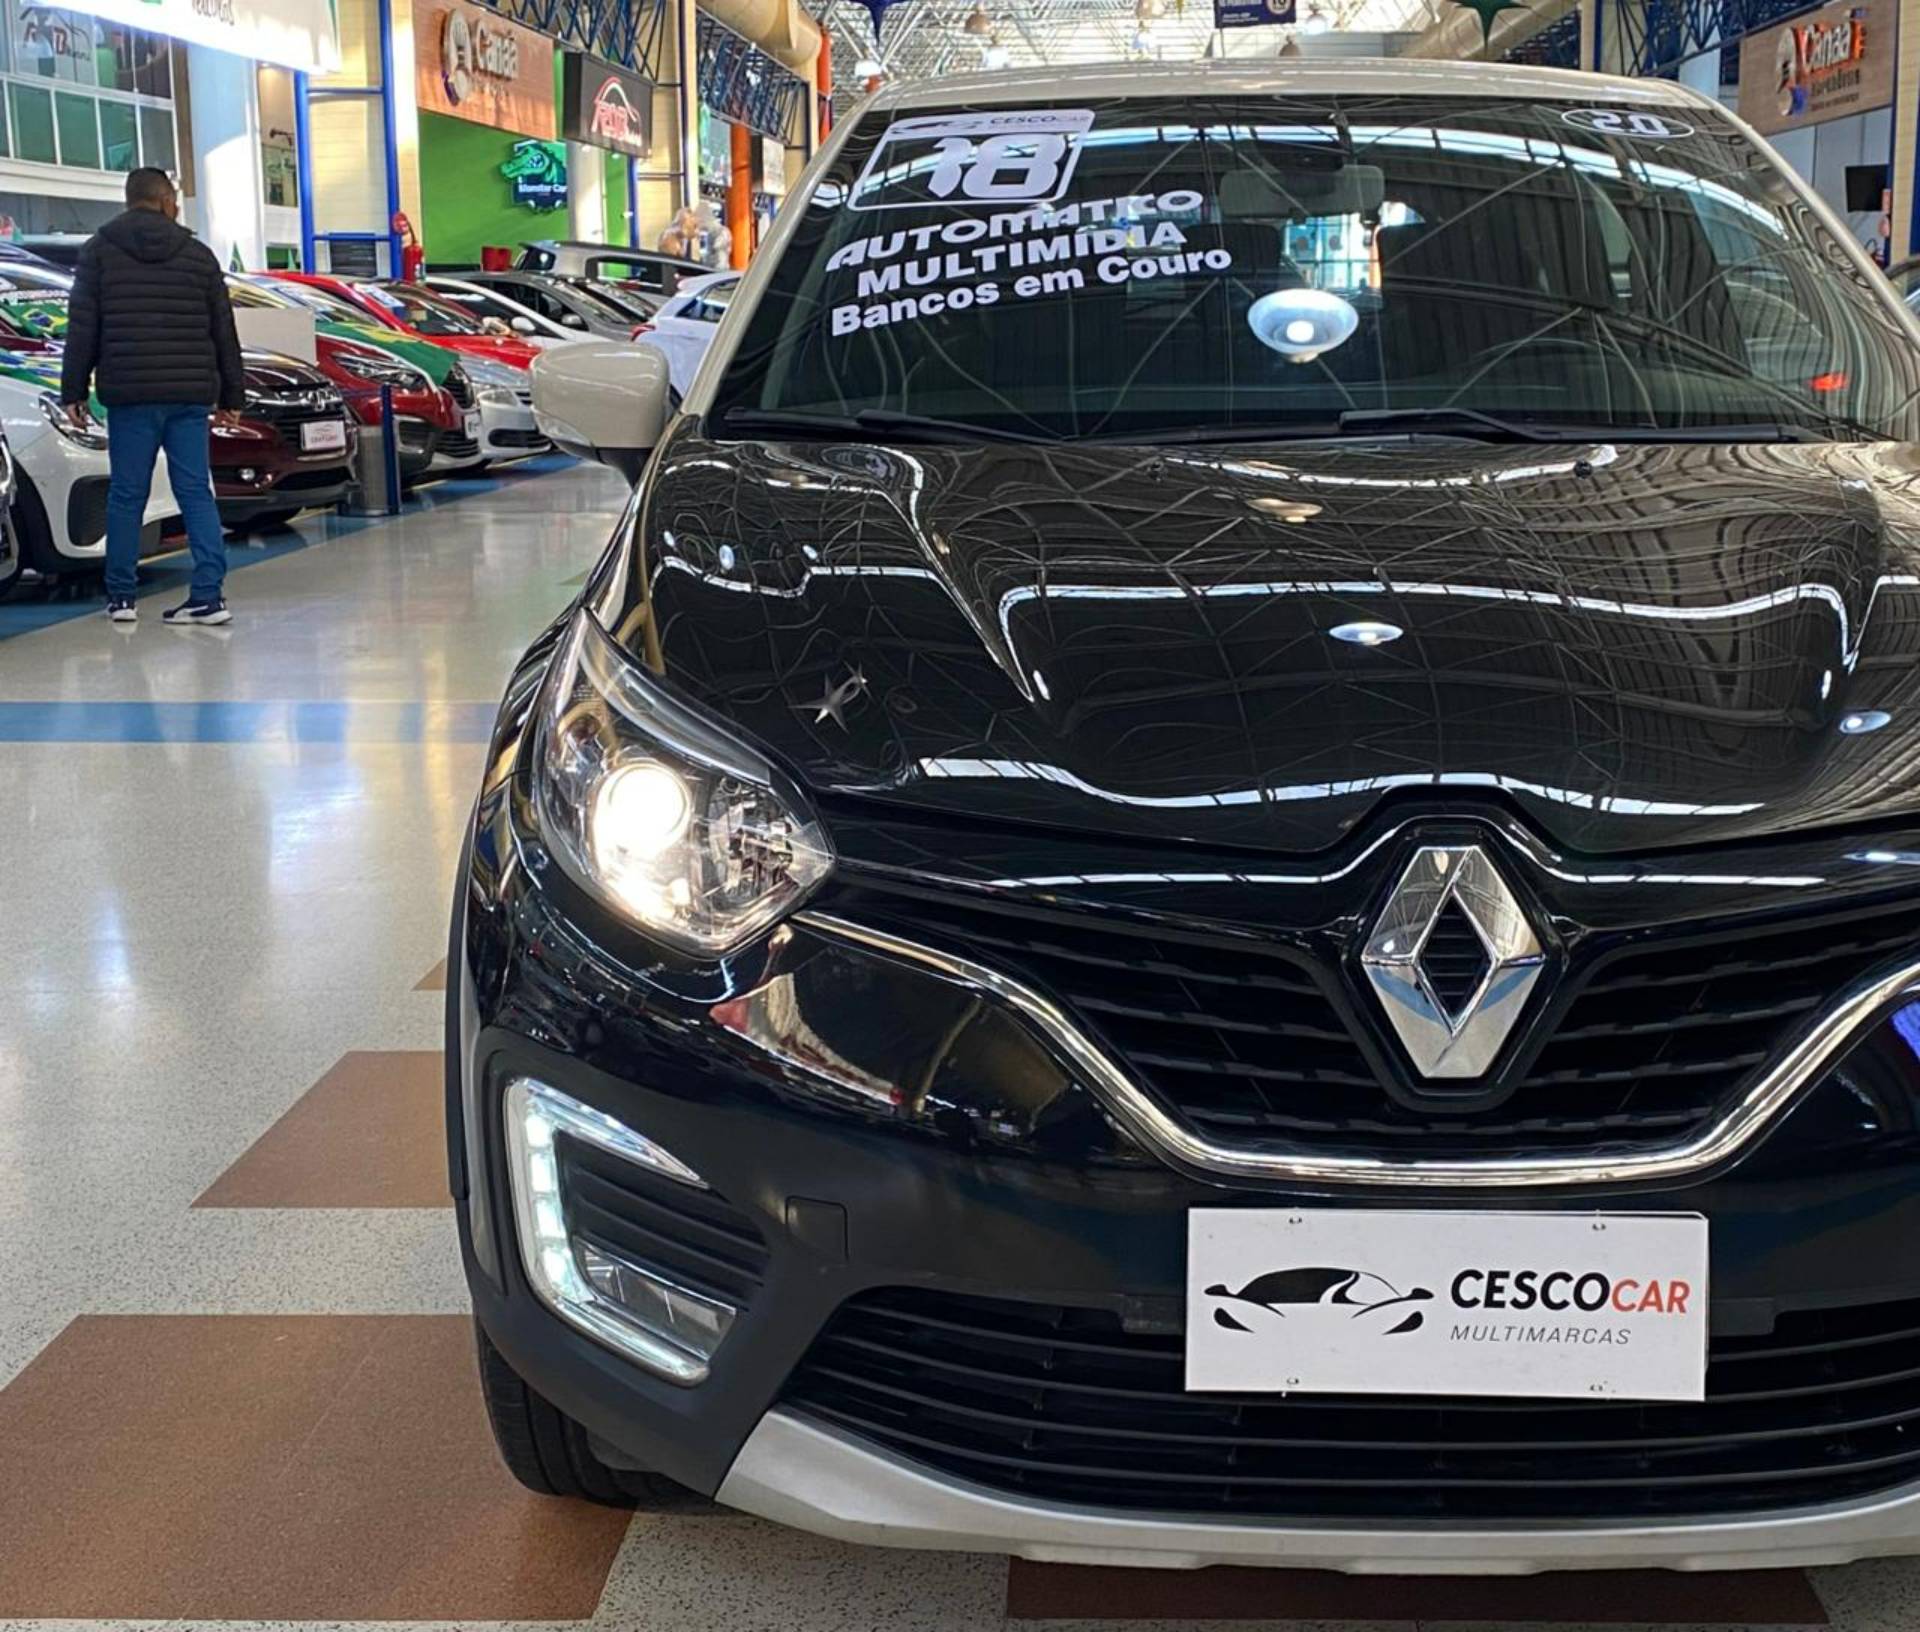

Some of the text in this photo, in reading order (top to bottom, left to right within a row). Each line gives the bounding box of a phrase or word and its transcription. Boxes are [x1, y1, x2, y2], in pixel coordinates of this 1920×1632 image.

[928, 133, 1067, 198] 18
[832, 249, 1232, 336] Bancos em Couro
[1451, 1269, 1691, 1314] CESCOCAR
[1450, 1325, 1631, 1345] MULTIMARCAS
